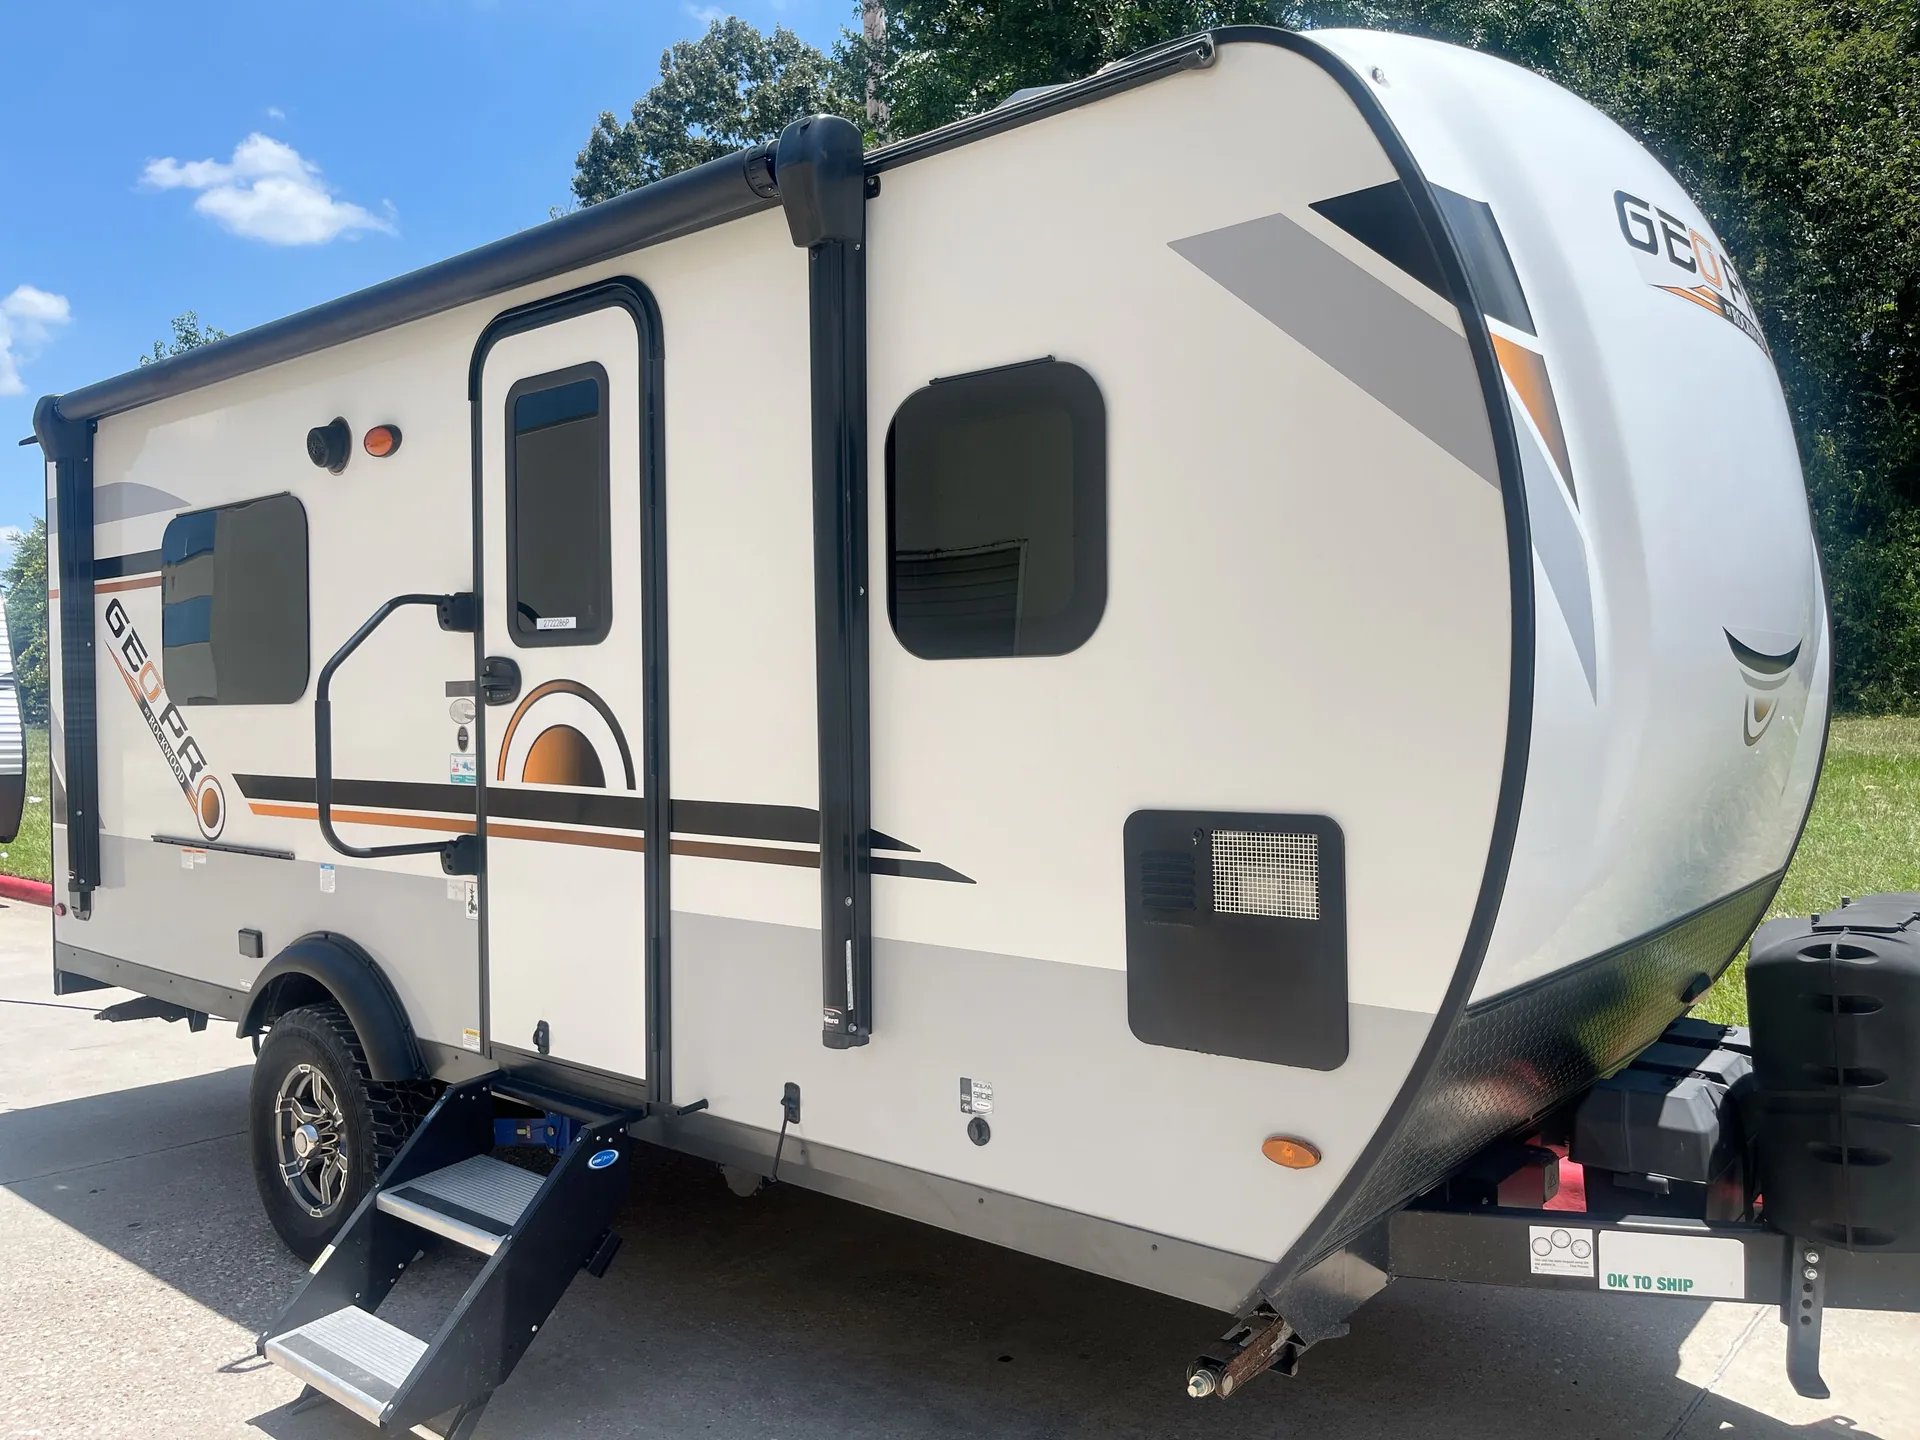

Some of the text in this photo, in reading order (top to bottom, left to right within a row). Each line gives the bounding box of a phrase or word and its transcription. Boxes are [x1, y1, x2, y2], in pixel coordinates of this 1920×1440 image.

[1613, 189, 1723, 290] GEO
[104, 598, 165, 703] GEO
[148, 715, 186, 784] ROCKWOOD
[972, 1090, 993, 1101] SIDE
[1607, 1273, 1694, 1292] OK TO SHIP
